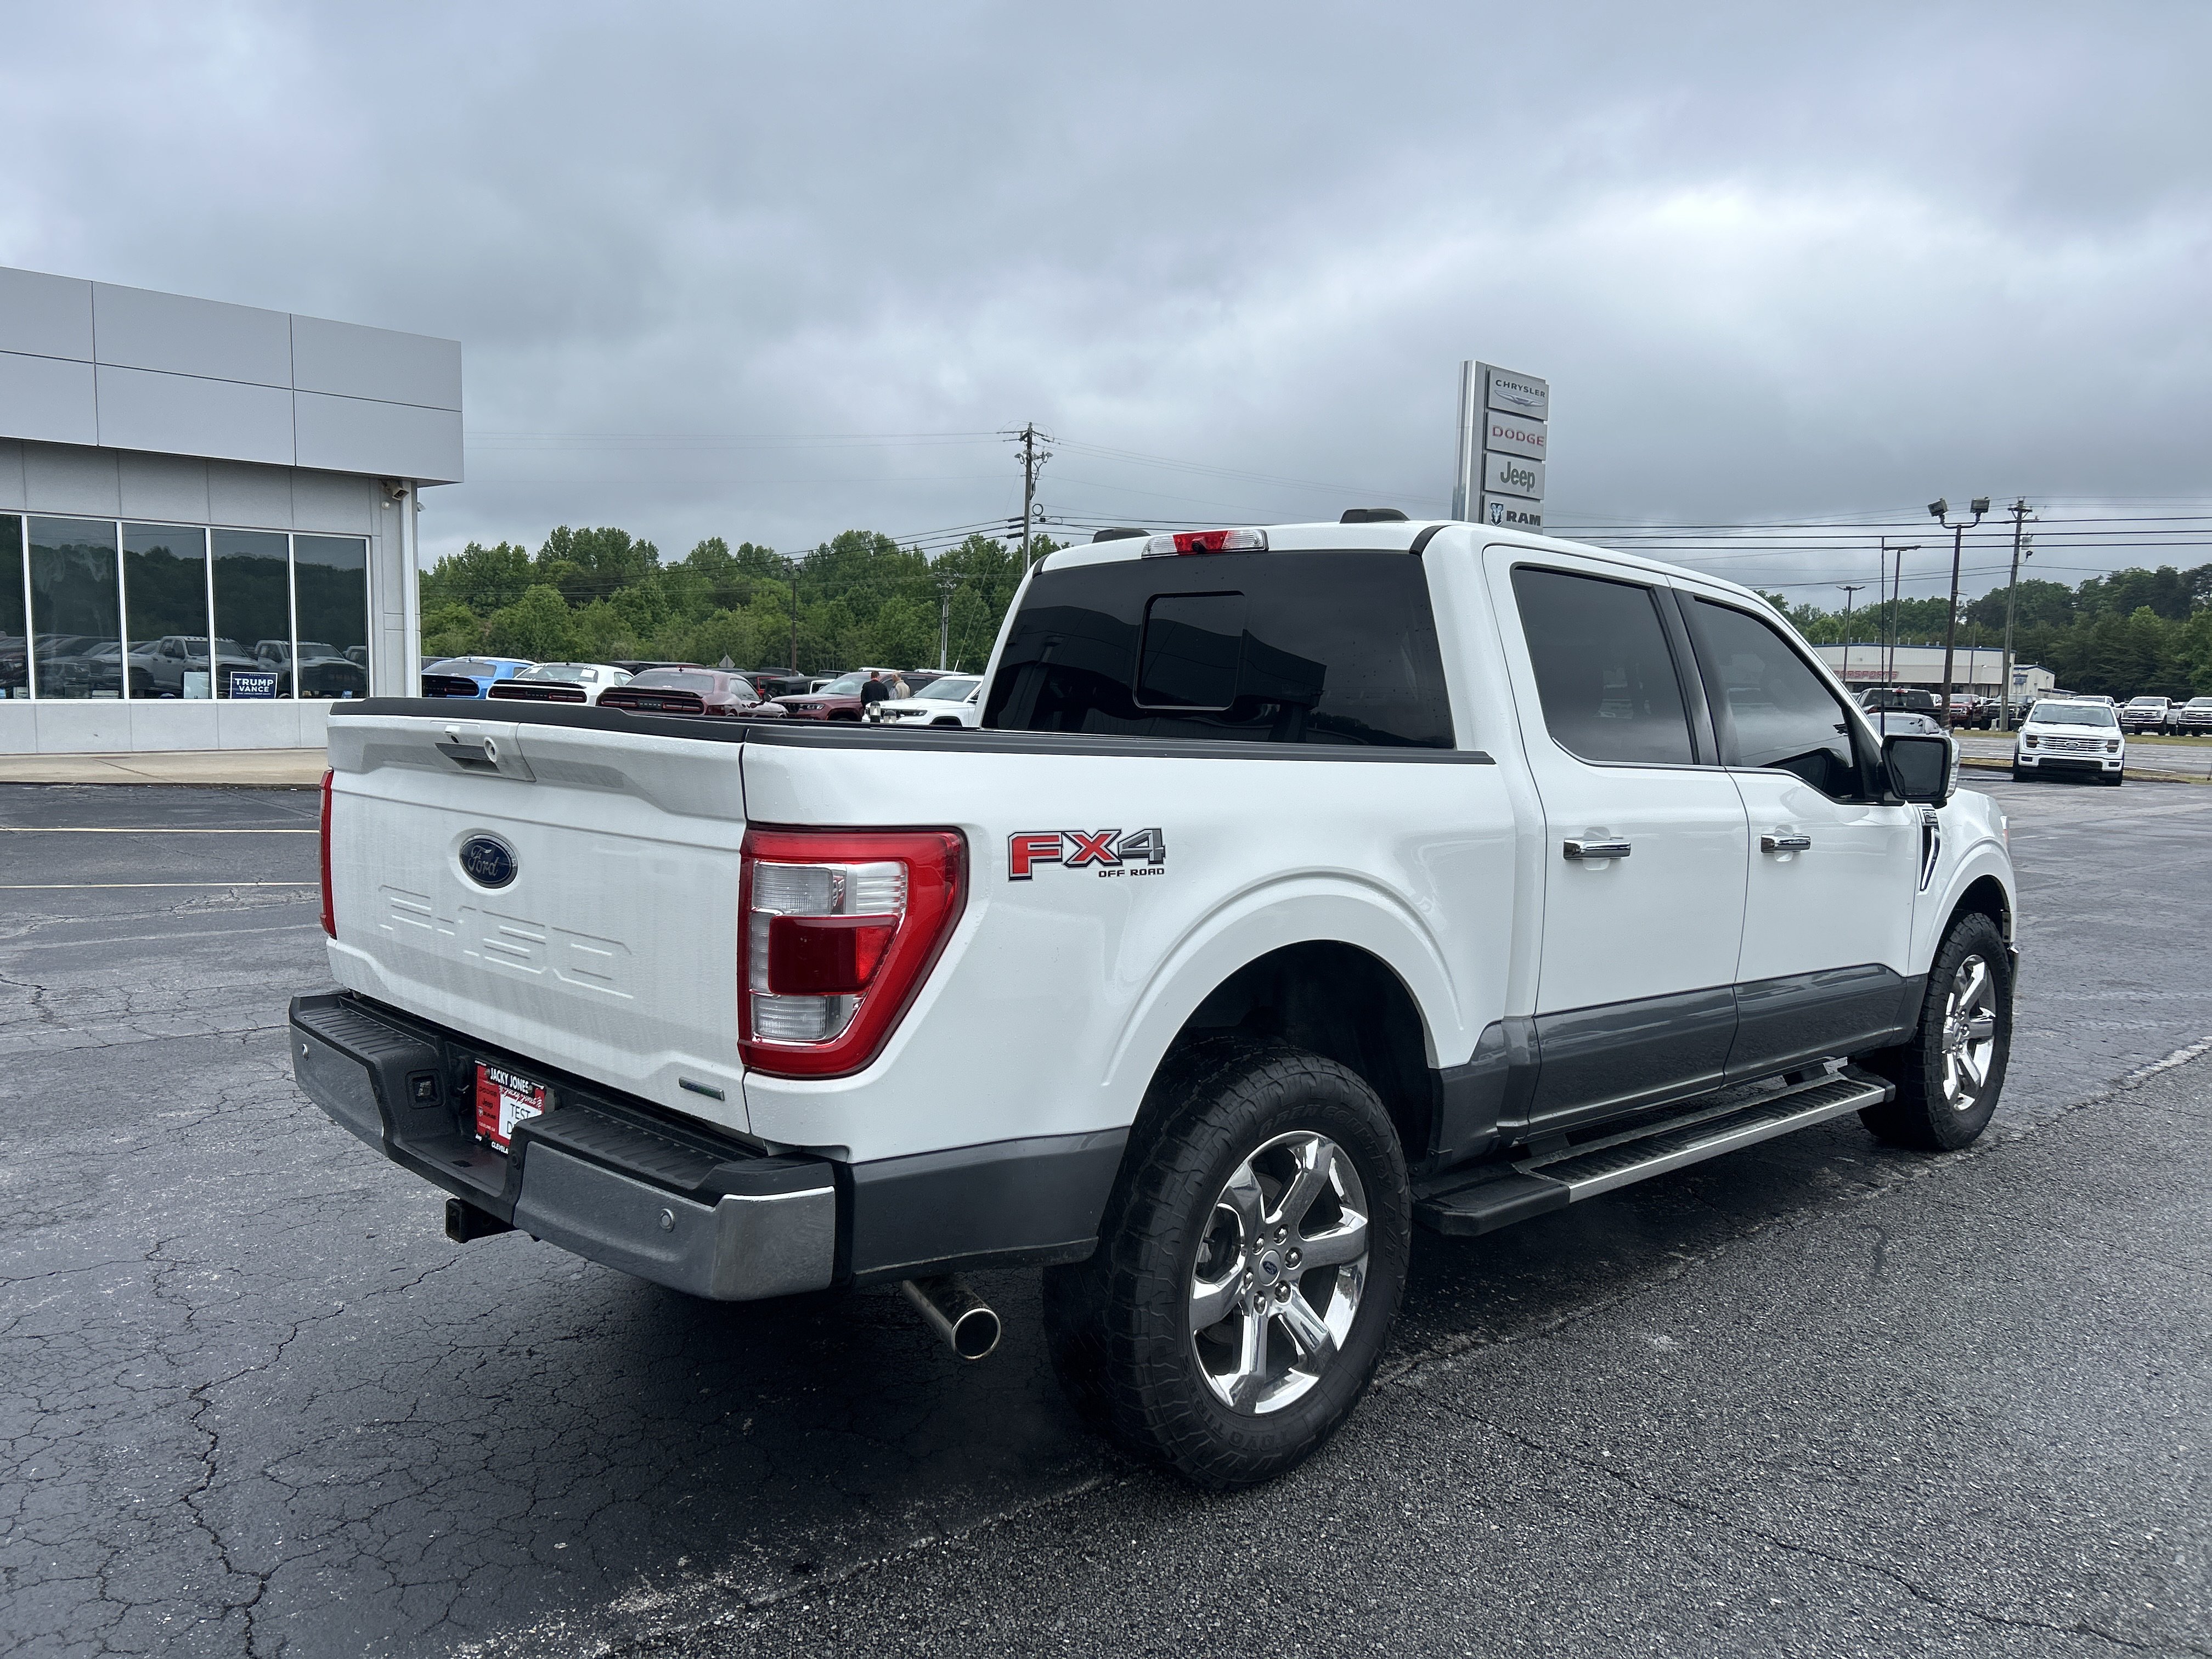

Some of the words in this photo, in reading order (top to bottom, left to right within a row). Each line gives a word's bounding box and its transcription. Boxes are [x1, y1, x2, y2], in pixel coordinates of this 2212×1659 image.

[1495, 379, 1545, 398] CHRYSLER
[1492, 425, 1545, 447] DODGE
[1500, 461, 1536, 492] Jeep
[1506, 511, 1541, 526] RAM
[235, 678, 274, 686] TRUMP
[1833, 670, 1898, 679] TORSPORTS
[468, 845, 500, 877] Ford
[1008, 827, 1166, 882] FX4
[1130, 868, 1164, 876] ROAD
[490, 1068, 509, 1086] JACKY
[510, 1075, 529, 1094] JONES
[510, 1103, 531, 1120] TEST
